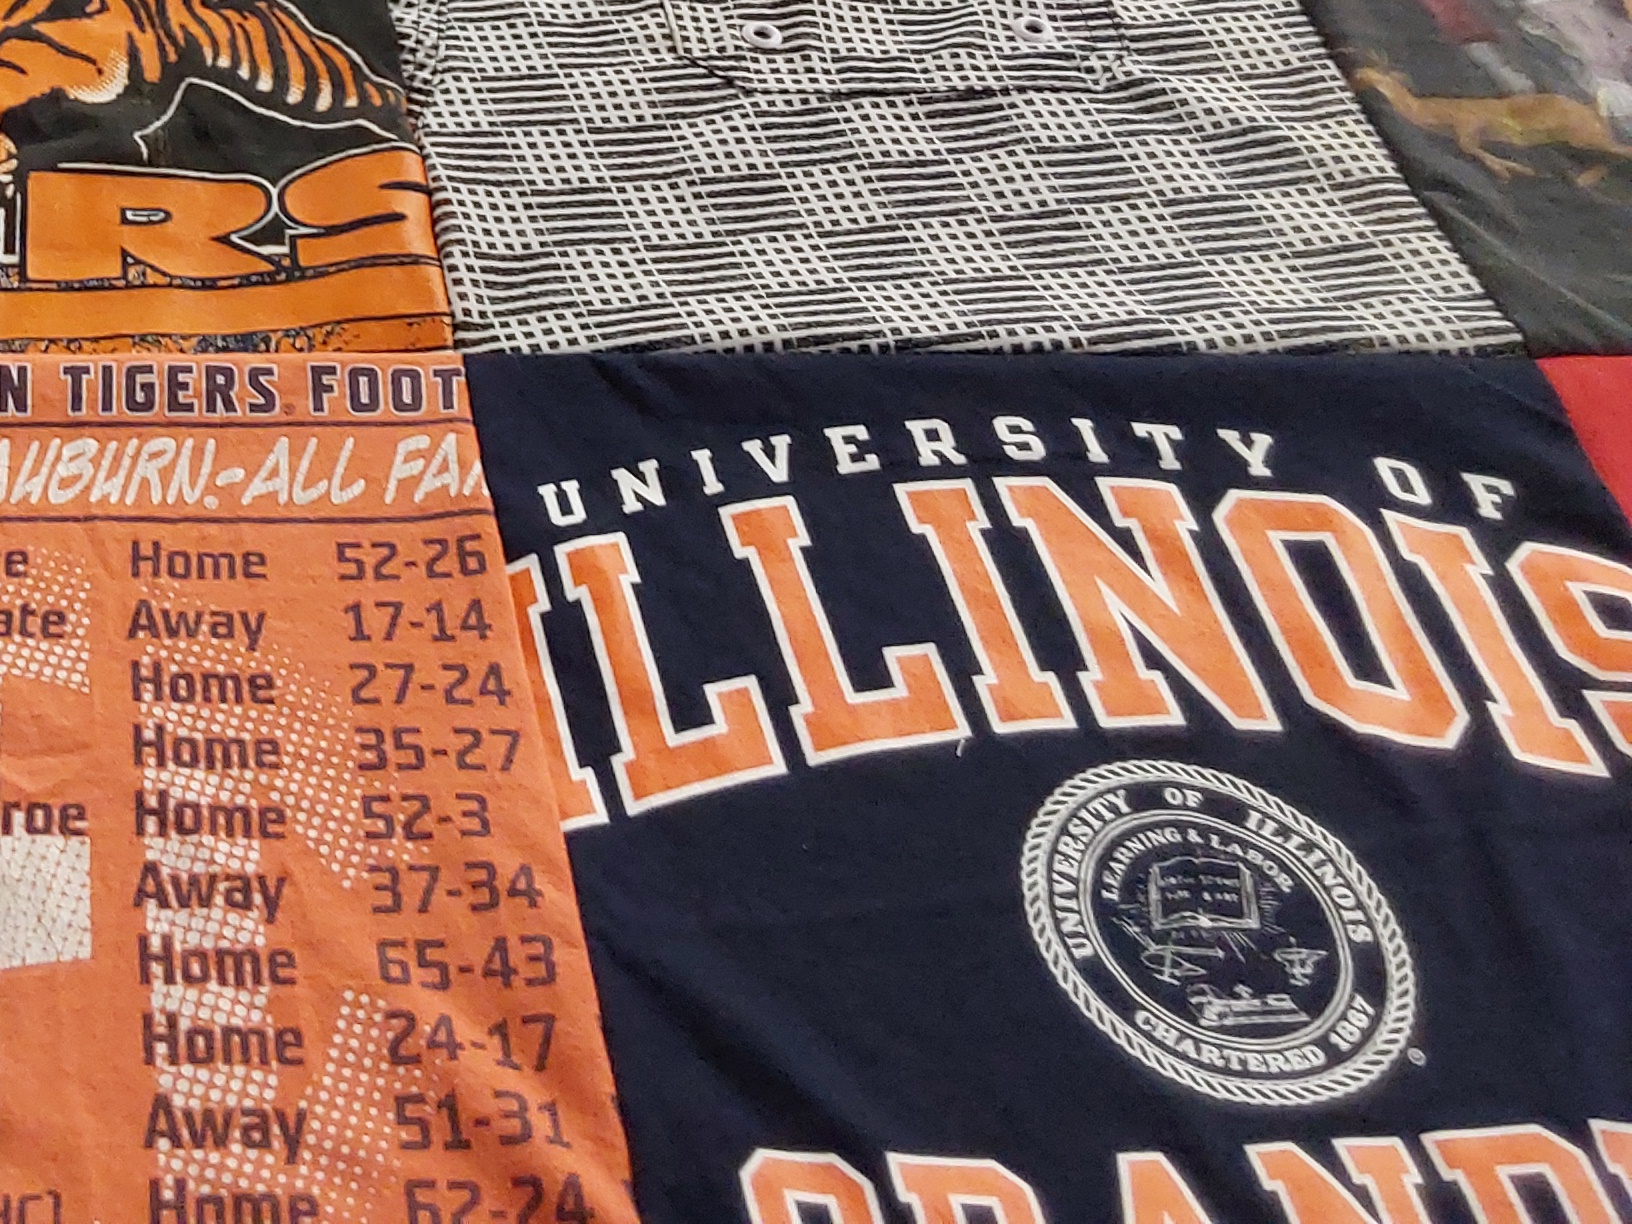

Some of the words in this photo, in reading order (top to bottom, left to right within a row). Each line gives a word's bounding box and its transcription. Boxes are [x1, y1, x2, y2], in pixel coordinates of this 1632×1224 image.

[60, 362, 278, 418] TIGERS
[308, 363, 466, 418] FOOT
[538, 414, 1275, 528] UNIVERSITY
[1375, 456, 1518, 524] OF
[130, 540, 268, 581] Home
[336, 535, 489, 582] 52-26
[127, 599, 267, 652] Away
[343, 598, 493, 643] 17-14
[130, 660, 276, 707] Home
[349, 661, 512, 707] 27-24
[132, 722, 282, 771] Home
[354, 726, 522, 773] 35-27
[134, 788, 288, 840] Home
[361, 792, 493, 842] 52-3
[132, 860, 289, 926] Away
[370, 859, 545, 915] 37-34
[1051, 788, 1131, 960] UNIVERSITY
[1163, 786, 1205, 810] OF
[1243, 808, 1374, 945] ILLINOIS
[1100, 825, 1183, 903] LEARNING
[1186, 826, 1204, 844] &
[1208, 834, 1295, 894] LABOR
[137, 932, 298, 988] Home
[376, 933, 558, 992] 65-43
[140, 1011, 305, 1067] Home
[382, 1009, 557, 1073] 24-17
[1134, 1010, 1326, 1075] CHARTERED
[1329, 993, 1376, 1053] 1867
[144, 1092, 308, 1166] Away
[394, 1089, 572, 1152] 51-31
